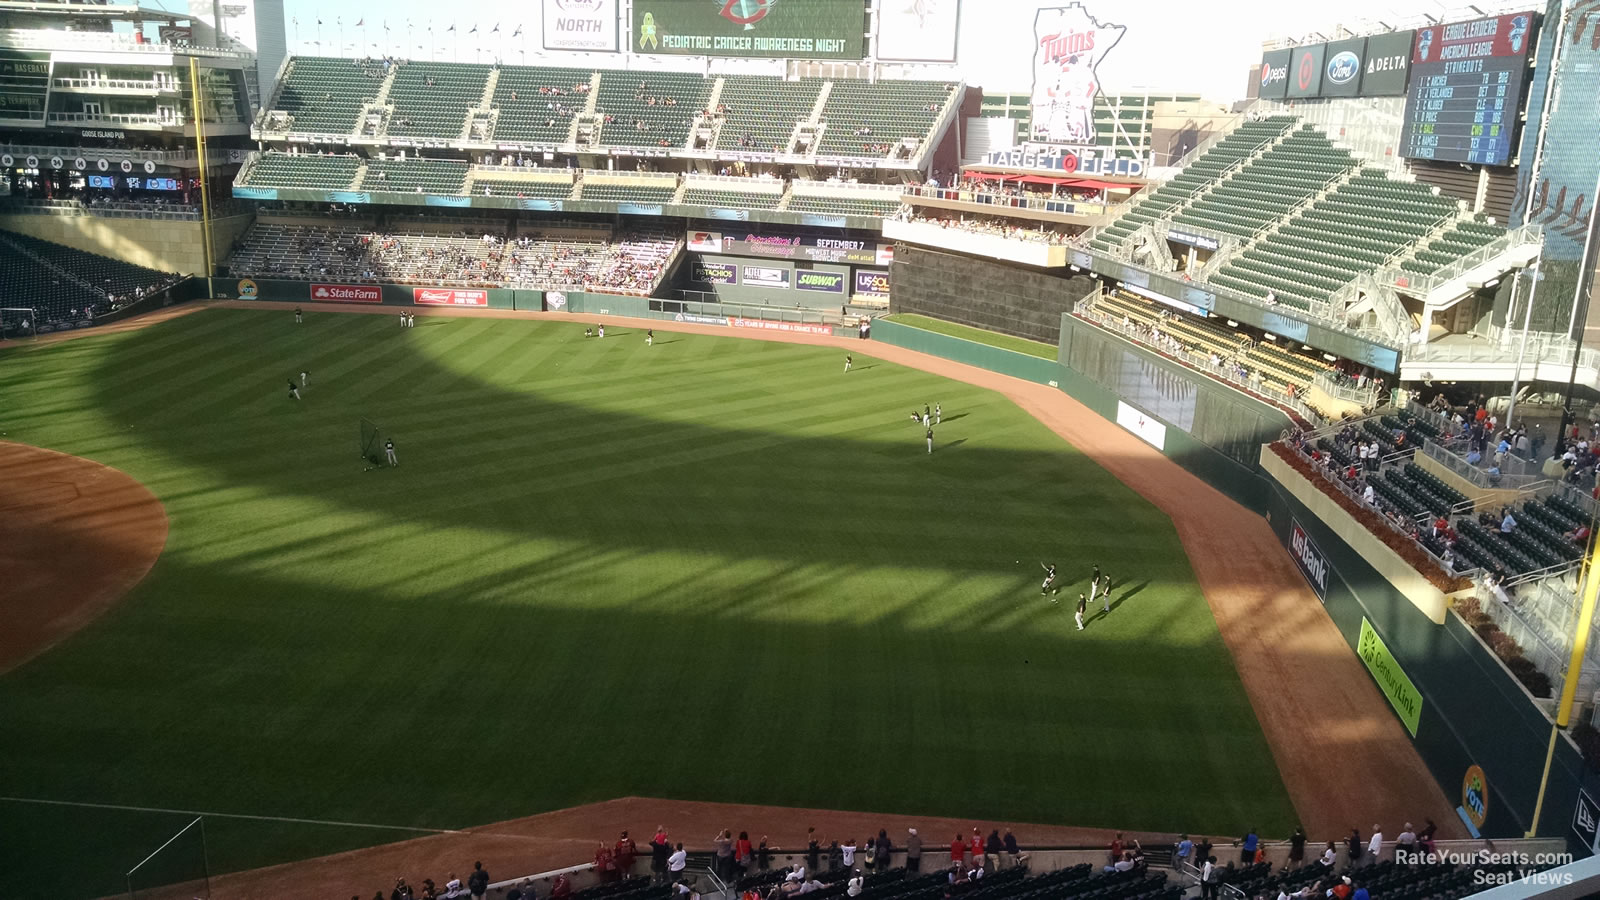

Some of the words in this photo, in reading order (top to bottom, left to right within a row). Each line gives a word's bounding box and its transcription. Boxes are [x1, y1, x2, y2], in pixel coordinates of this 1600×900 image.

[556, 18, 602, 32] NORTH
[1442, 23, 1465, 41] LEAGUE
[1466, 19, 1498, 38] LEADERS
[662, 35, 711, 48] PEDIATRIC
[714, 36, 751, 49] CANCER
[754, 37, 813, 51] AWARENESS
[816, 39, 846, 53] NIGHT
[1040, 29, 1095, 65] Twins
[1440, 43, 1468, 60] AMERICAN
[1469, 41, 1494, 57] LEAGUE
[14, 63, 48, 74] BASEBALL
[1332, 59, 1352, 78] Ford
[1376, 55, 1406, 72] DELTA
[1444, 59, 1484, 74] STRIKEOUTS
[1269, 64, 1287, 83] pepsi
[1476, 98, 1486, 110] CLE
[82, 130, 97, 138] GOOSE
[1471, 138, 1480, 149] TEX
[1467, 151, 1479, 161] NYY
[988, 152, 1060, 169] TARGET
[1080, 160, 1144, 177] FIELD
[817, 239, 857, 250] SEPTEMBER
[859, 242, 864, 250] 7
[812, 254, 840, 262] SHOWCASE
[696, 268, 733, 277] PISTACHIOS
[798, 274, 841, 287] SUBWAY
[555, 296, 564, 304] 29
[735, 318, 744, 327] 25
[744, 320, 758, 328] YEARS
[1375, 651, 1415, 718] CenturyLink
[1466, 782, 1484, 819] VOTE
